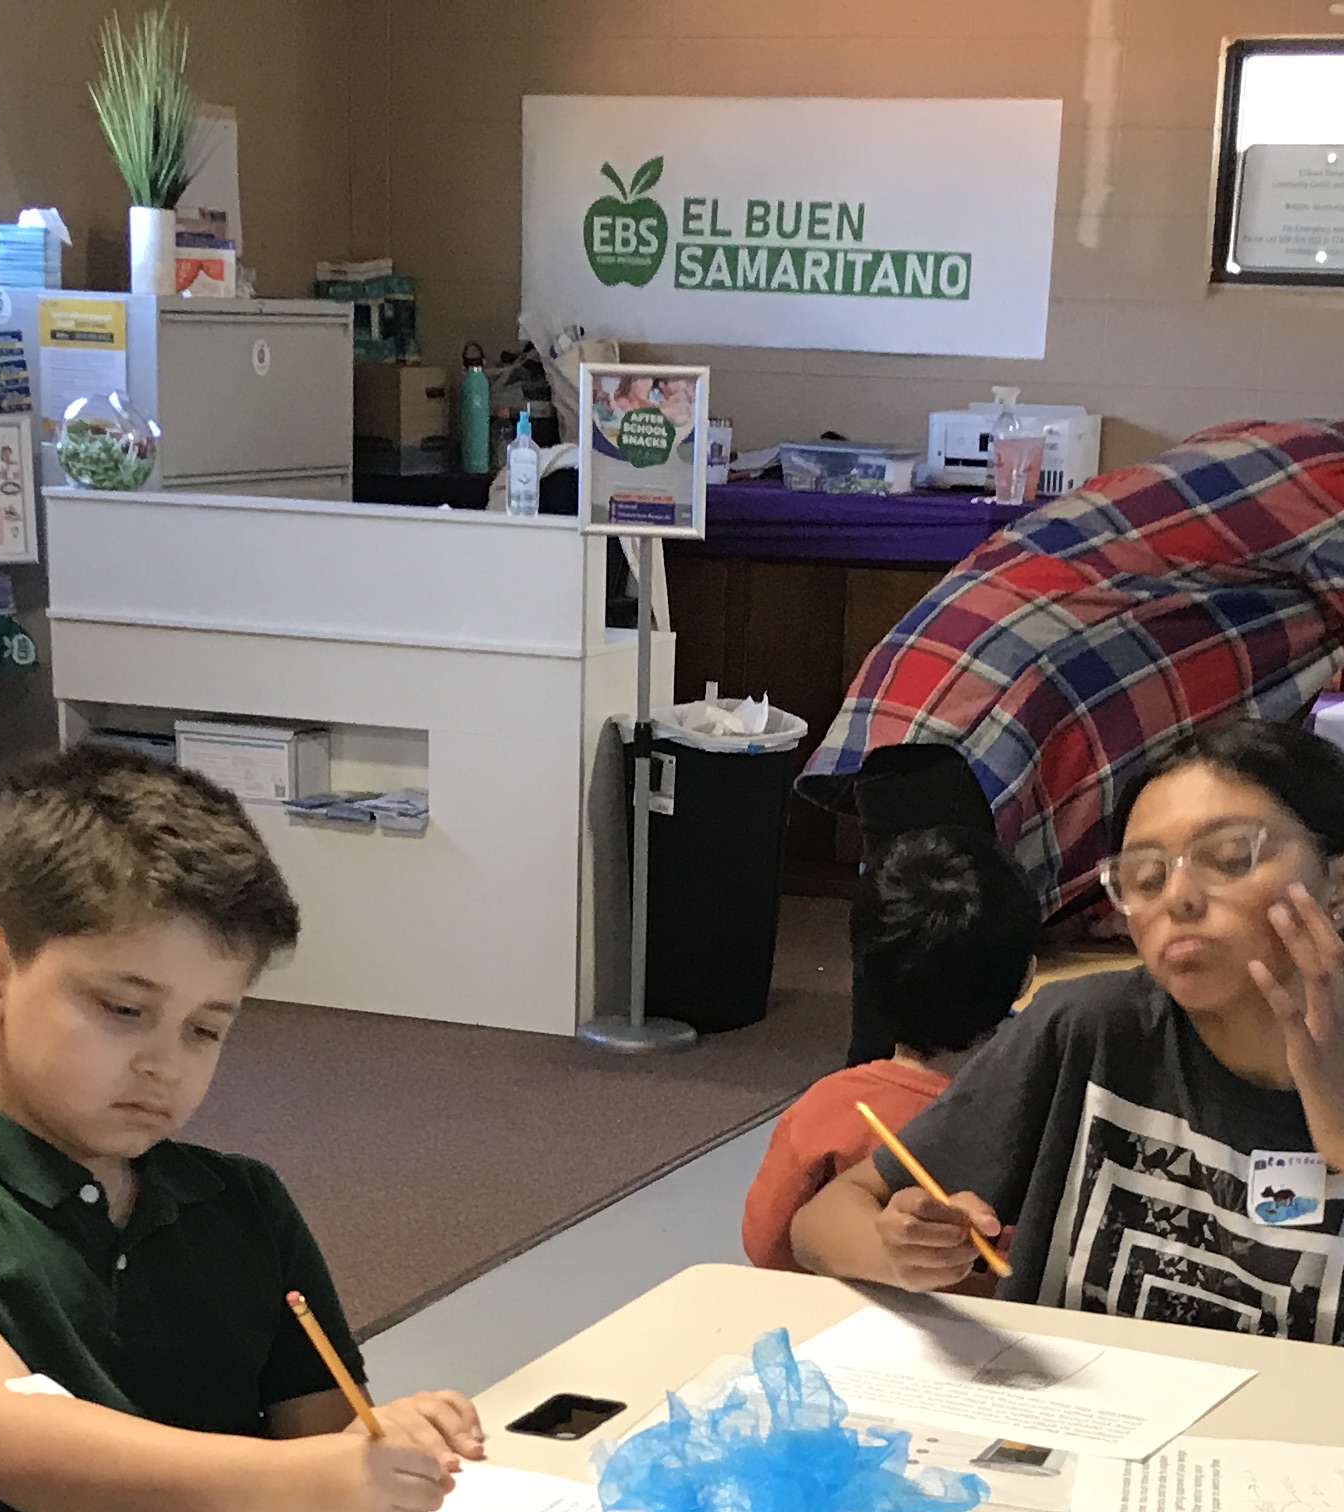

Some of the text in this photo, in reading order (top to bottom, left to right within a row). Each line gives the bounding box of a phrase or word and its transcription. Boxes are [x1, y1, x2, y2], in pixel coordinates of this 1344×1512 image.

[683, 197, 865, 242] EL BUEN
[593, 216, 659, 254] EBS
[678, 246, 968, 296] SAMARITANO
[623, 422, 668, 437] SCHOOL
[631, 412, 664, 424] AFTER
[622, 434, 667, 449] SNACKS
